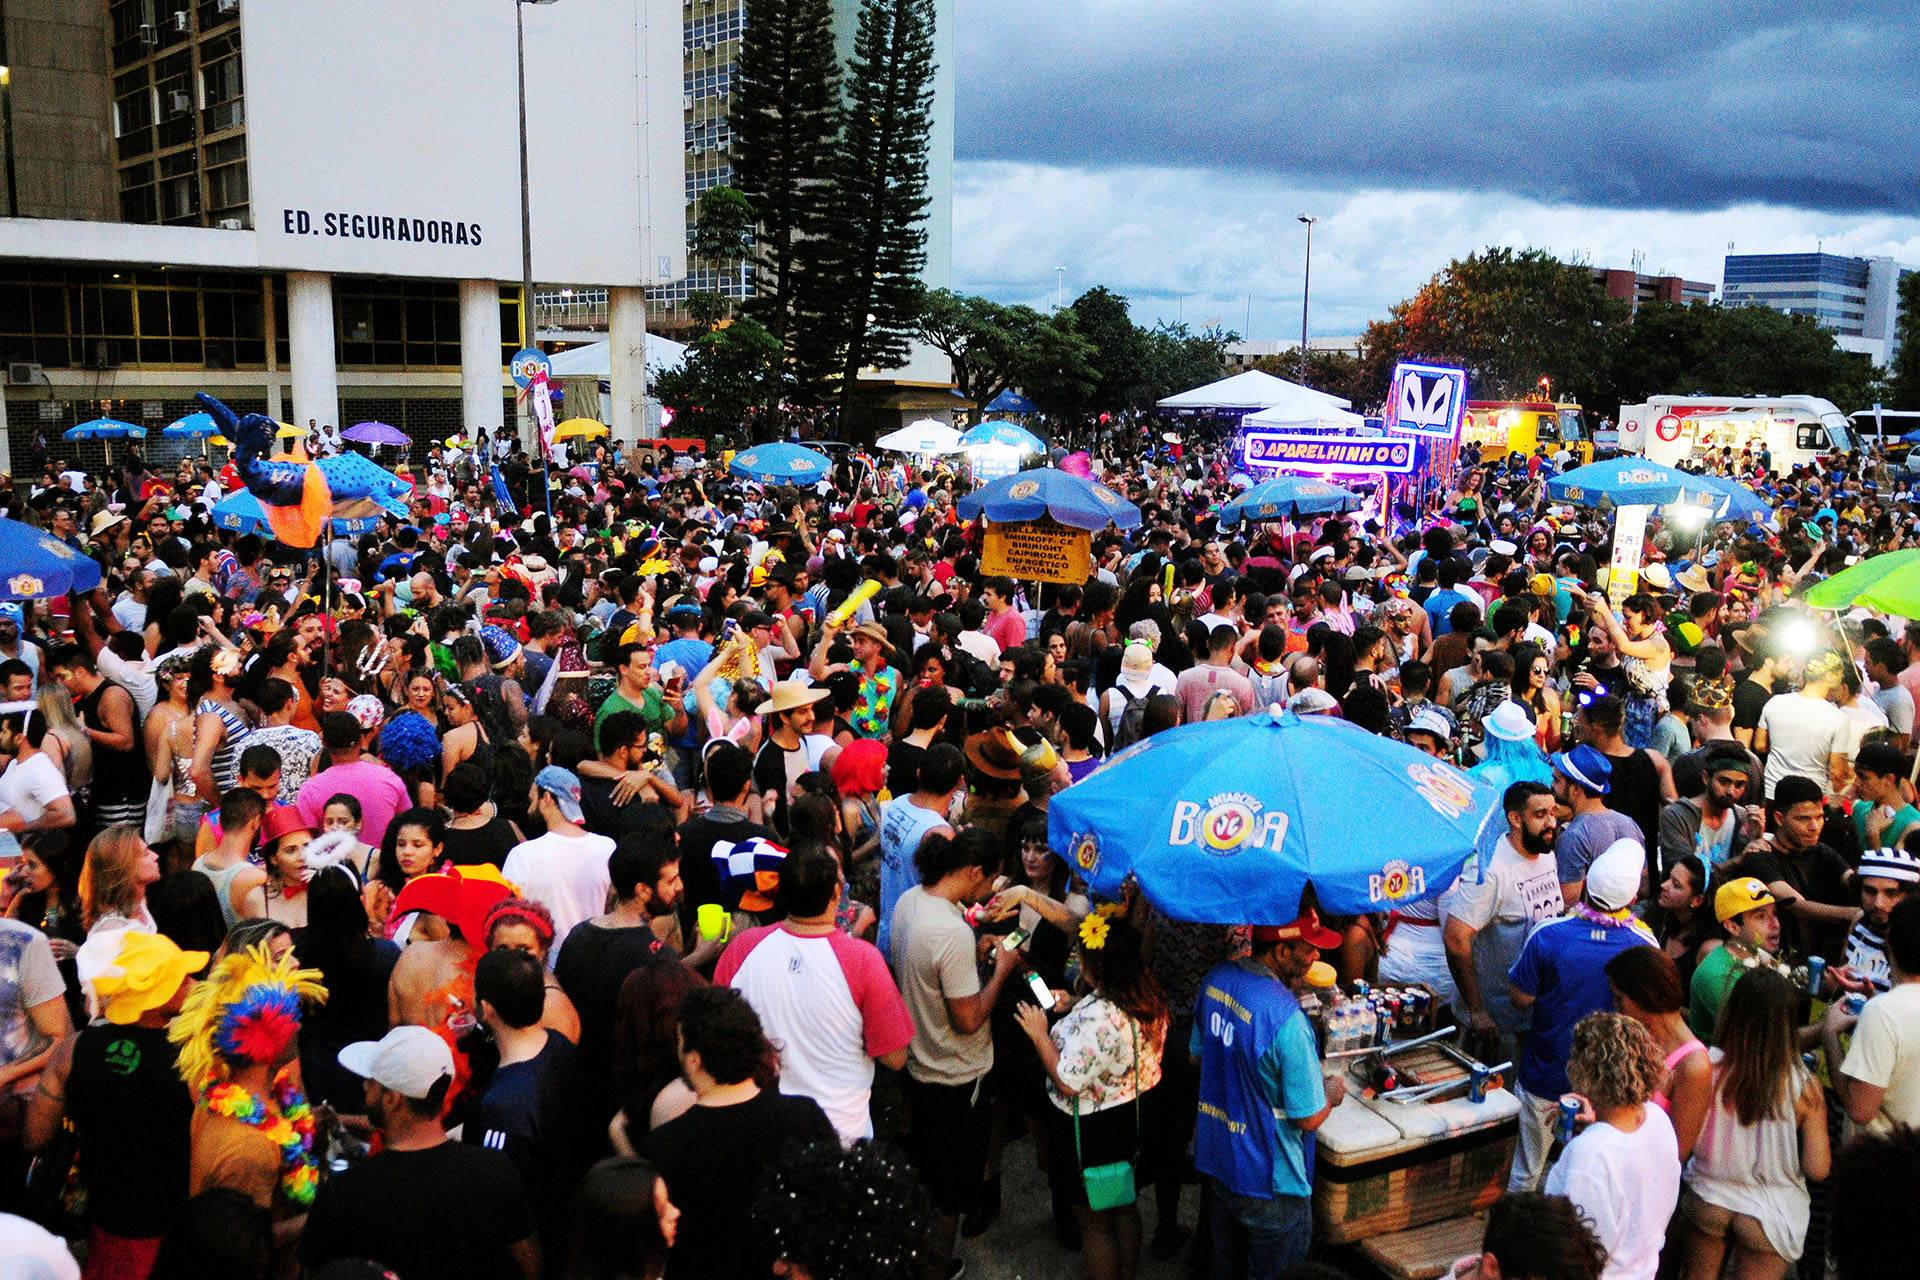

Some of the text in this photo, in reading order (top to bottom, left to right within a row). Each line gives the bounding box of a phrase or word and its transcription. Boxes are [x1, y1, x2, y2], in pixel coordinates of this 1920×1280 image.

[284, 209, 482, 246] ED. SEGURADORAS
[1265, 442, 1389, 463] APARELHINHO
[1008, 548, 1068, 560] CAIPIROSCA
